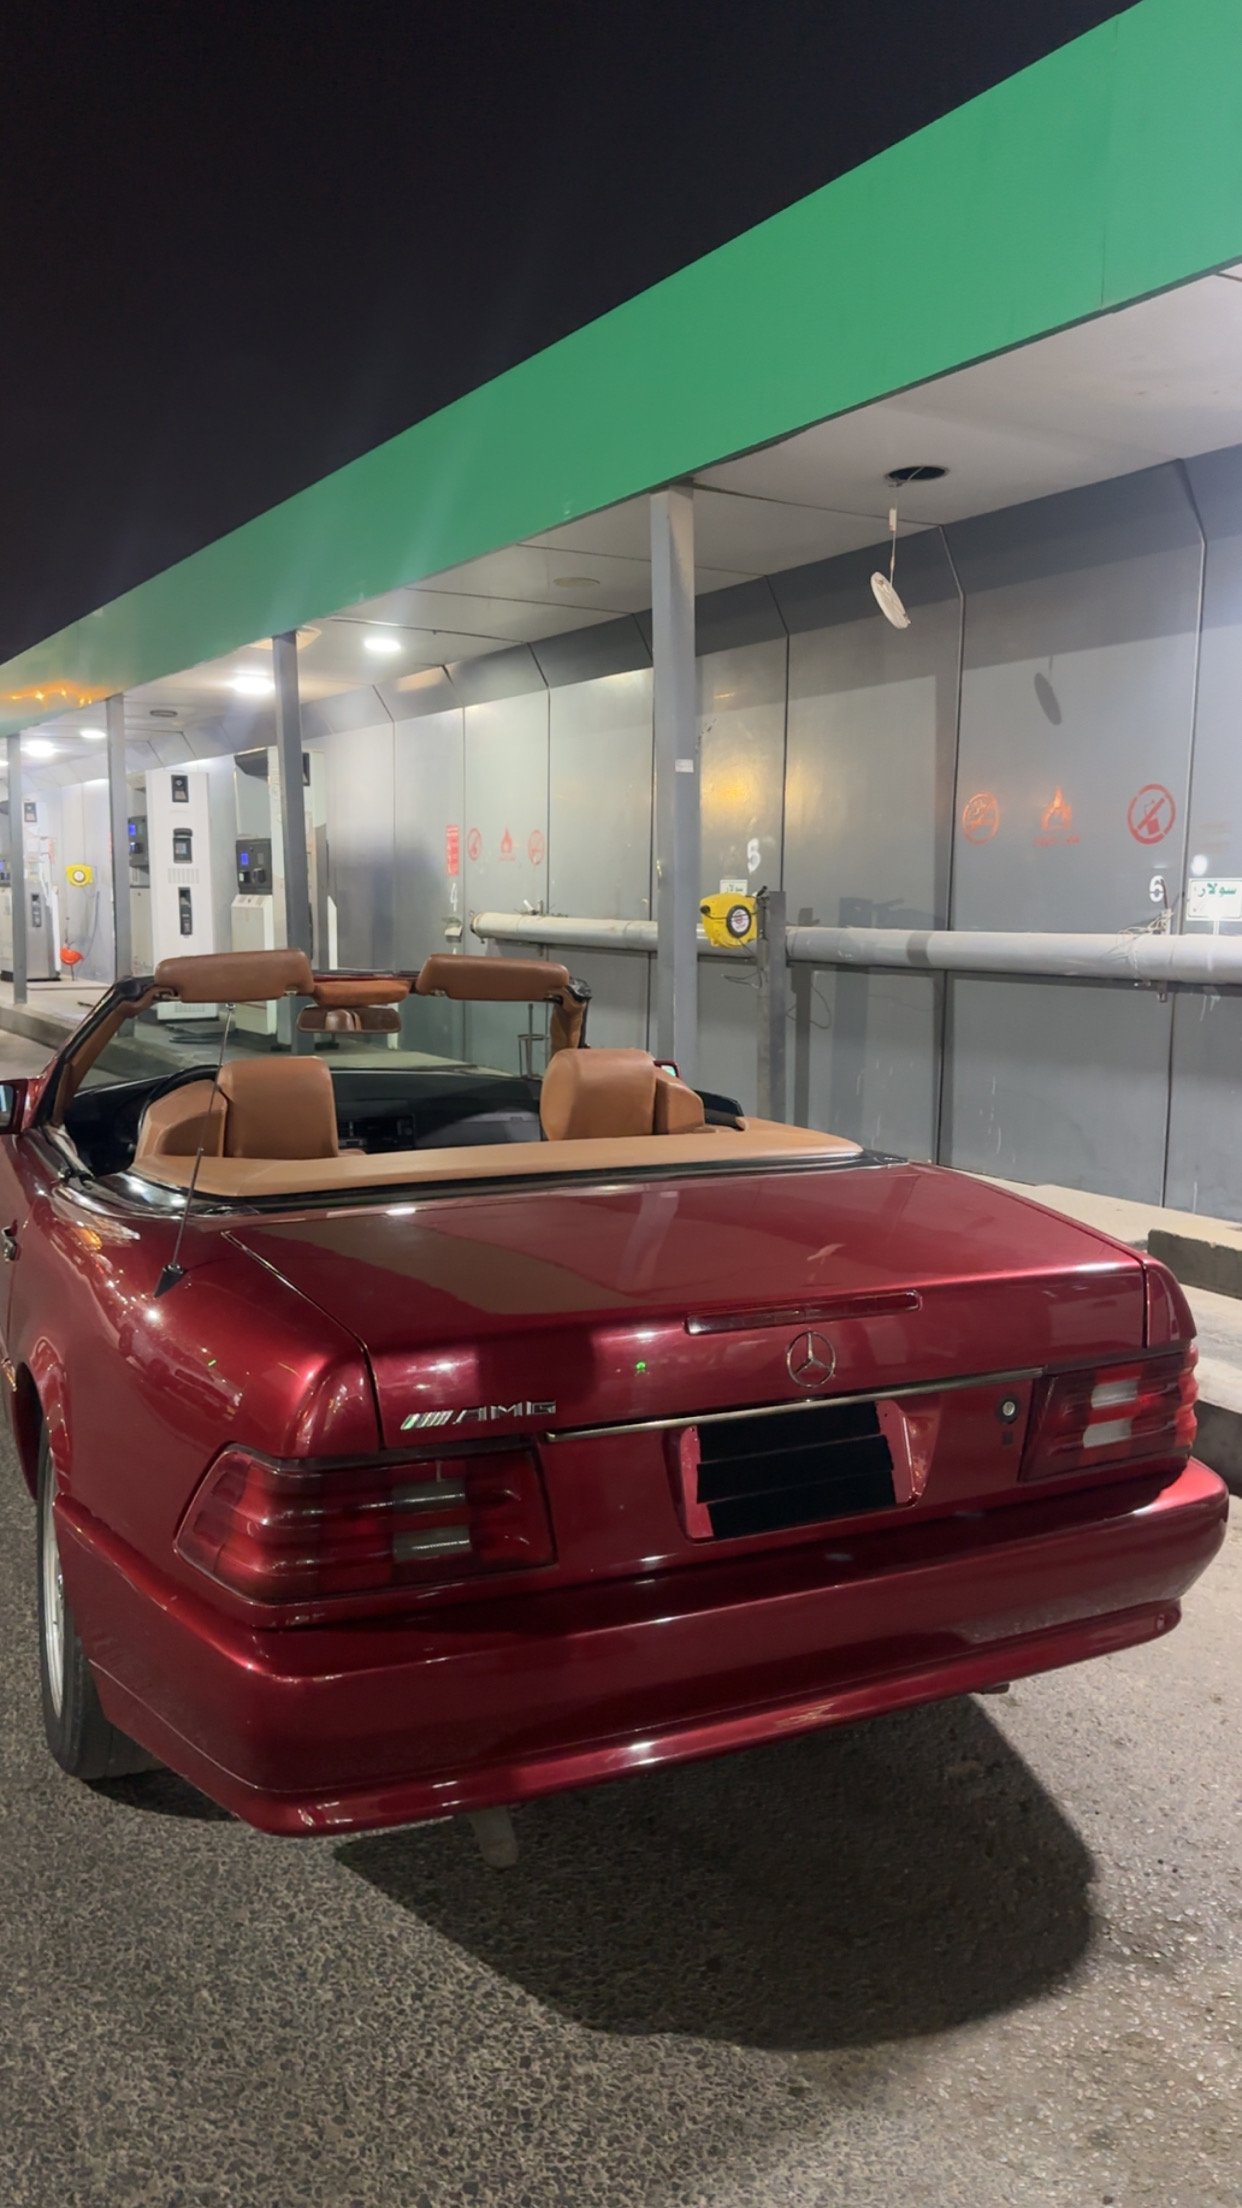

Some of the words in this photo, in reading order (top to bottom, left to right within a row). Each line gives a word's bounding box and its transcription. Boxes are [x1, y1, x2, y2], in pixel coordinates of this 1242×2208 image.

[746, 838, 761, 874] 5
[1149, 875, 1165, 903] 6
[452, 1401, 557, 1425] AMG
